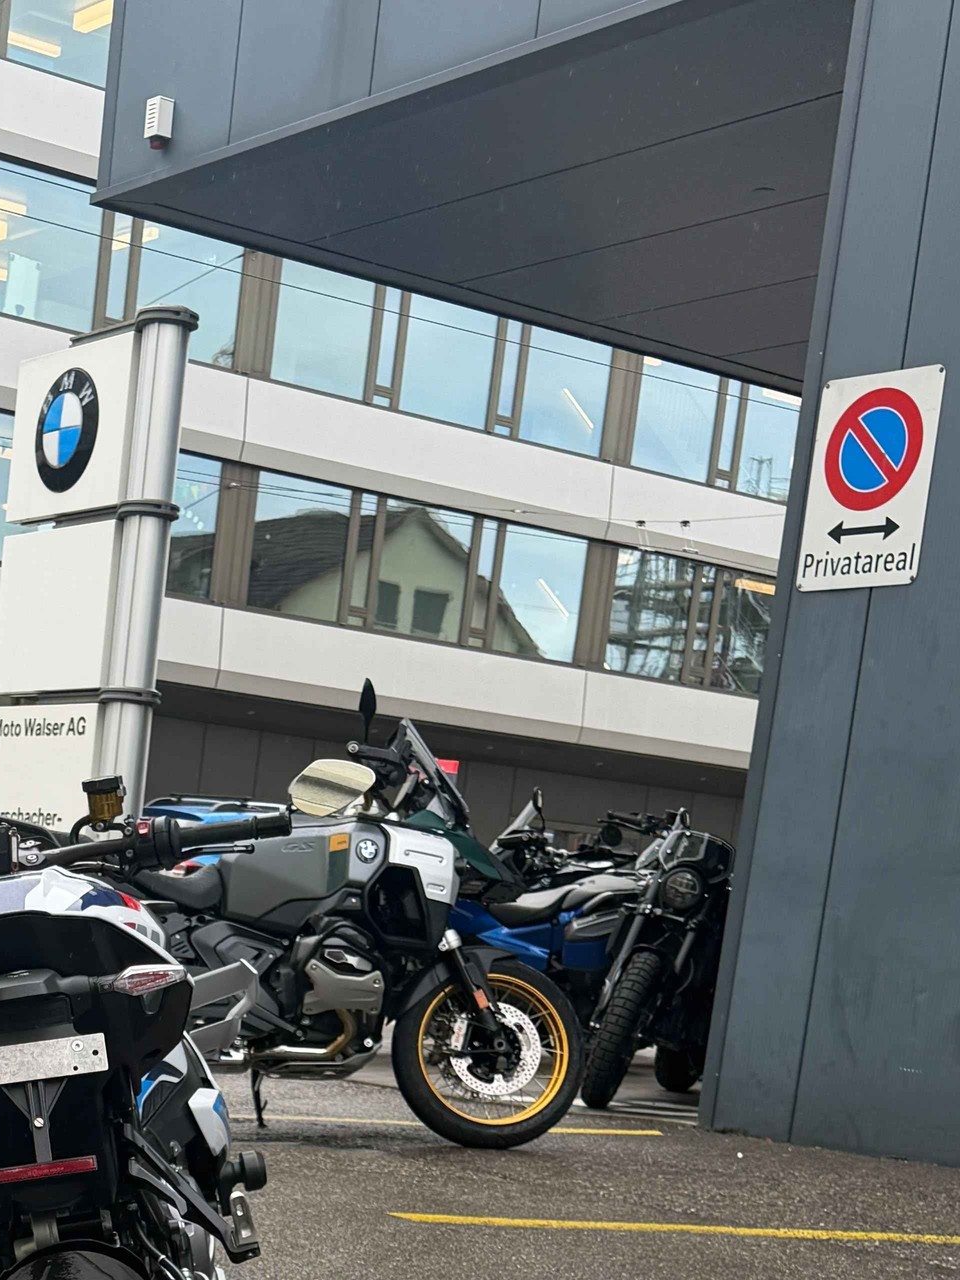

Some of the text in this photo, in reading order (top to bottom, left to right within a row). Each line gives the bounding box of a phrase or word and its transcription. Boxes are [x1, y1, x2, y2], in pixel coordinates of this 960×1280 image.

[42, 370, 95, 414] BMW
[802, 542, 916, 578] Privatareal
[24, 717, 65, 737] Walser
[65, 716, 87, 736] AG
